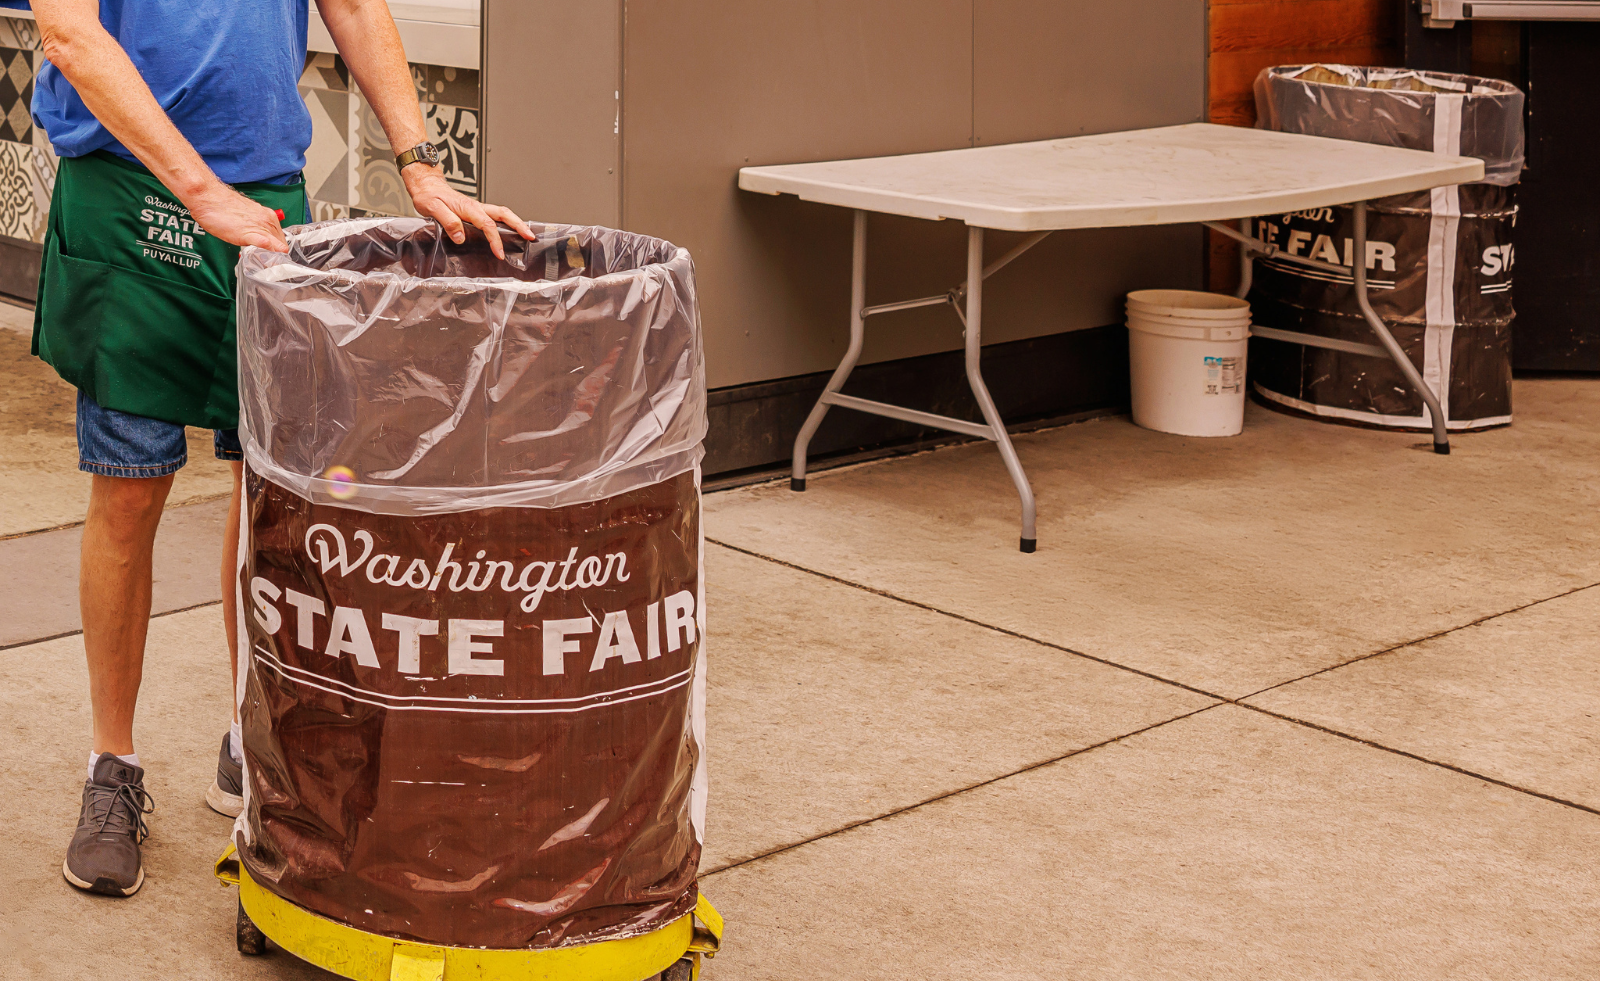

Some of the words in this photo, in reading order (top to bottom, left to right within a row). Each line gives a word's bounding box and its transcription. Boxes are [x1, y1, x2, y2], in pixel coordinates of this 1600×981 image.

[144, 195, 191, 216] Washing
[140, 208, 206, 236] STATE
[147, 226, 194, 249] FAIR
[143, 248, 200, 269] PUYALLUP
[304, 523, 631, 613] Washington
[250, 575, 505, 677] STATE
[542, 589, 697, 677] FAIR
